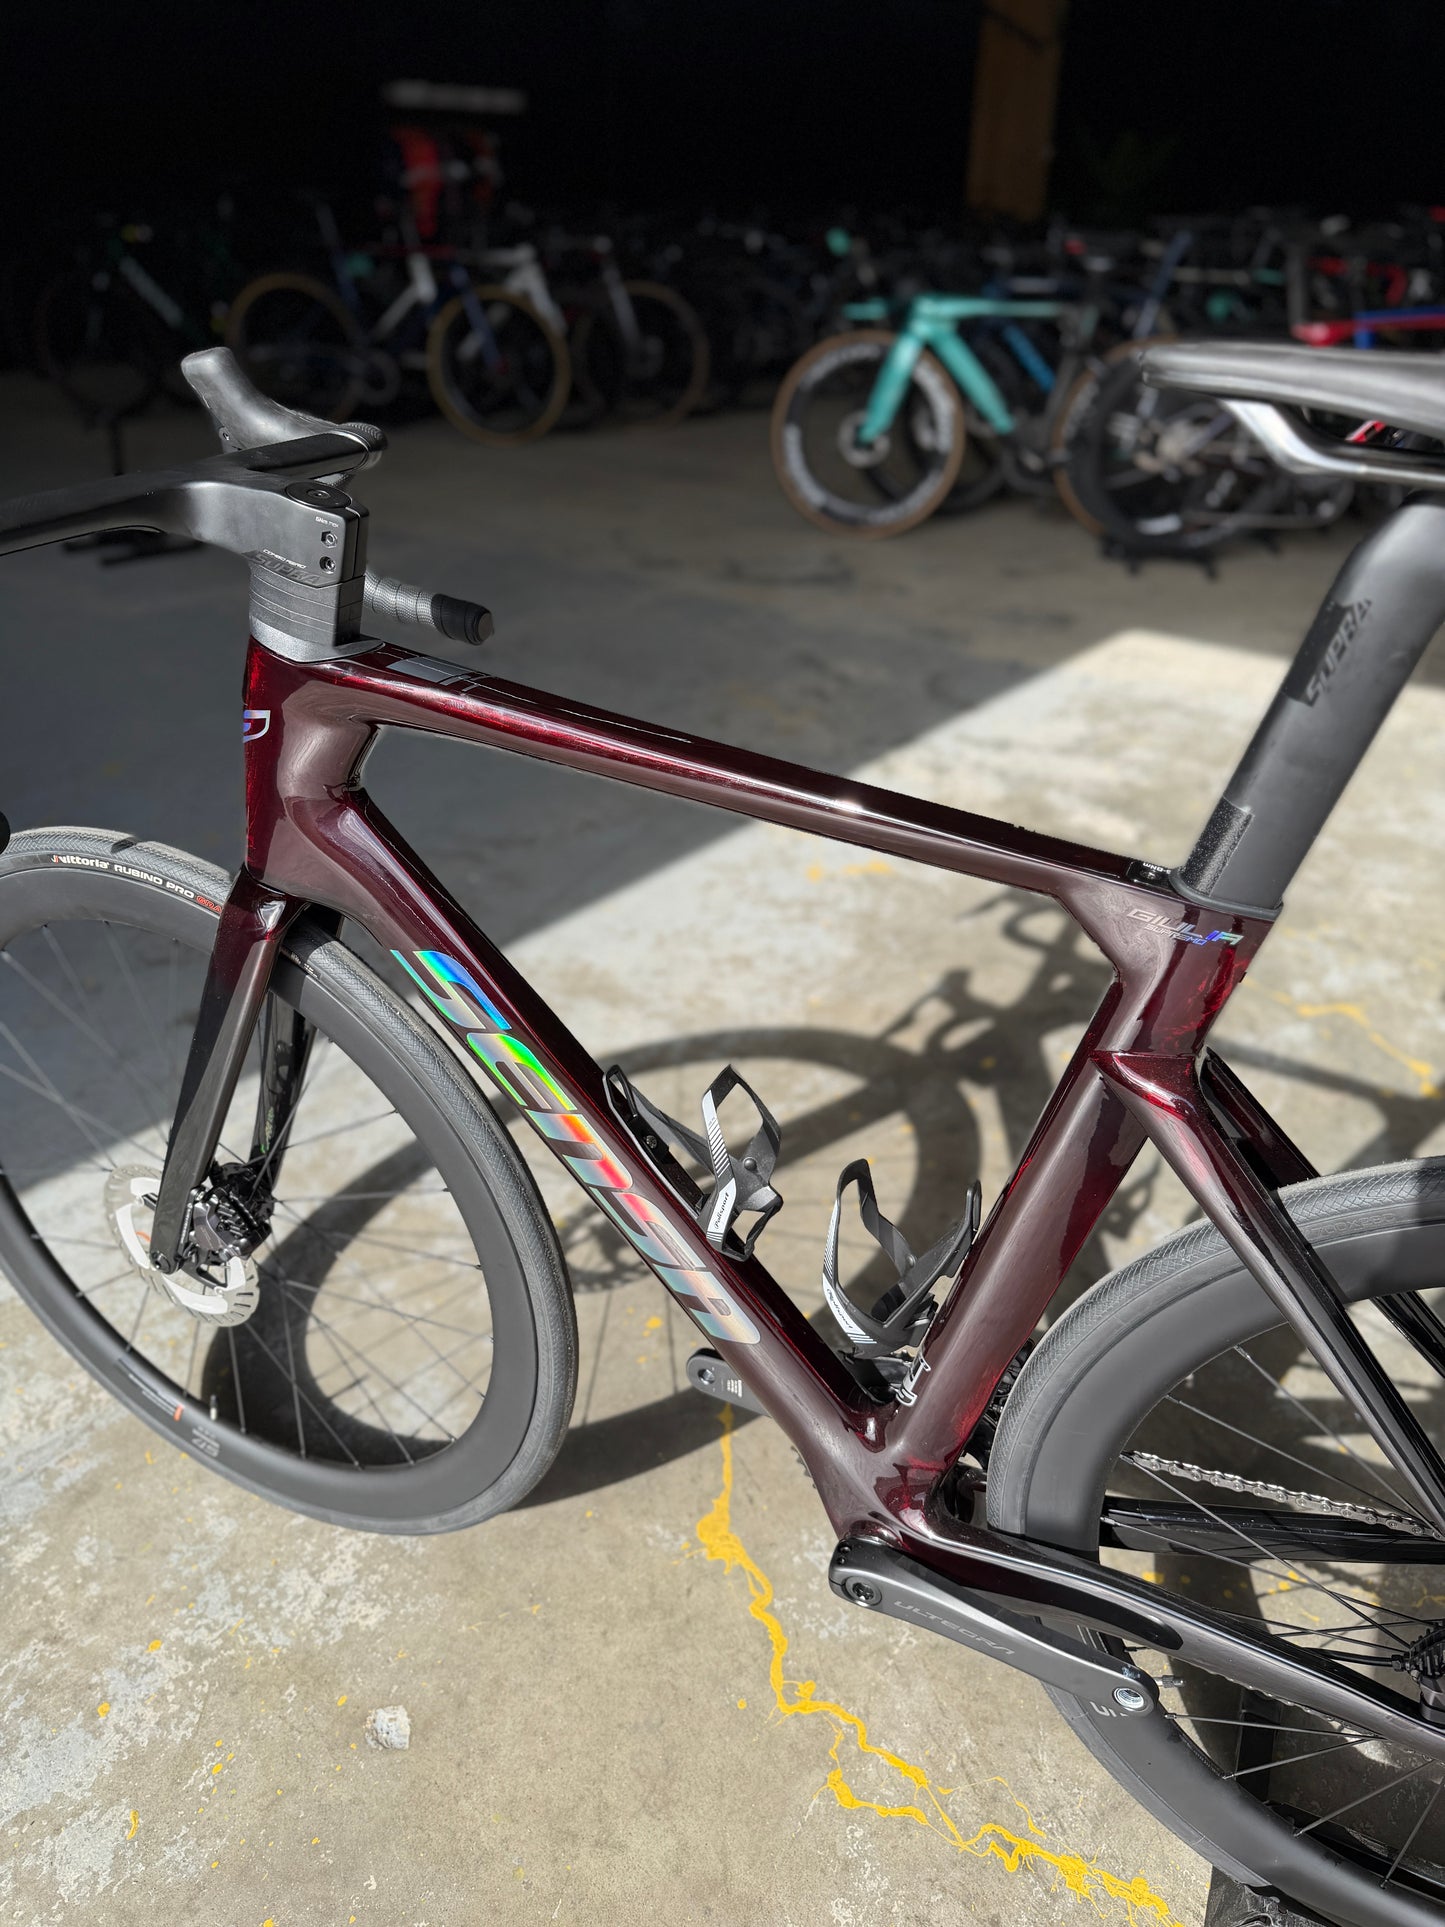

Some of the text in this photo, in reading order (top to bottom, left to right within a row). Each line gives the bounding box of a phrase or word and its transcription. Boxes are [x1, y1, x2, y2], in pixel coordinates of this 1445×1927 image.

[254, 553, 321, 584] SUPRA
[1305, 599, 1373, 706] SUPRA
[114, 864, 163, 886] RUBINO
[165, 881, 195, 899] PRO
[1127, 908, 1244, 945] GIULIA
[1144, 923, 1207, 946] SUPREMO
[894, 1600, 1016, 1656] ULTEGRA
